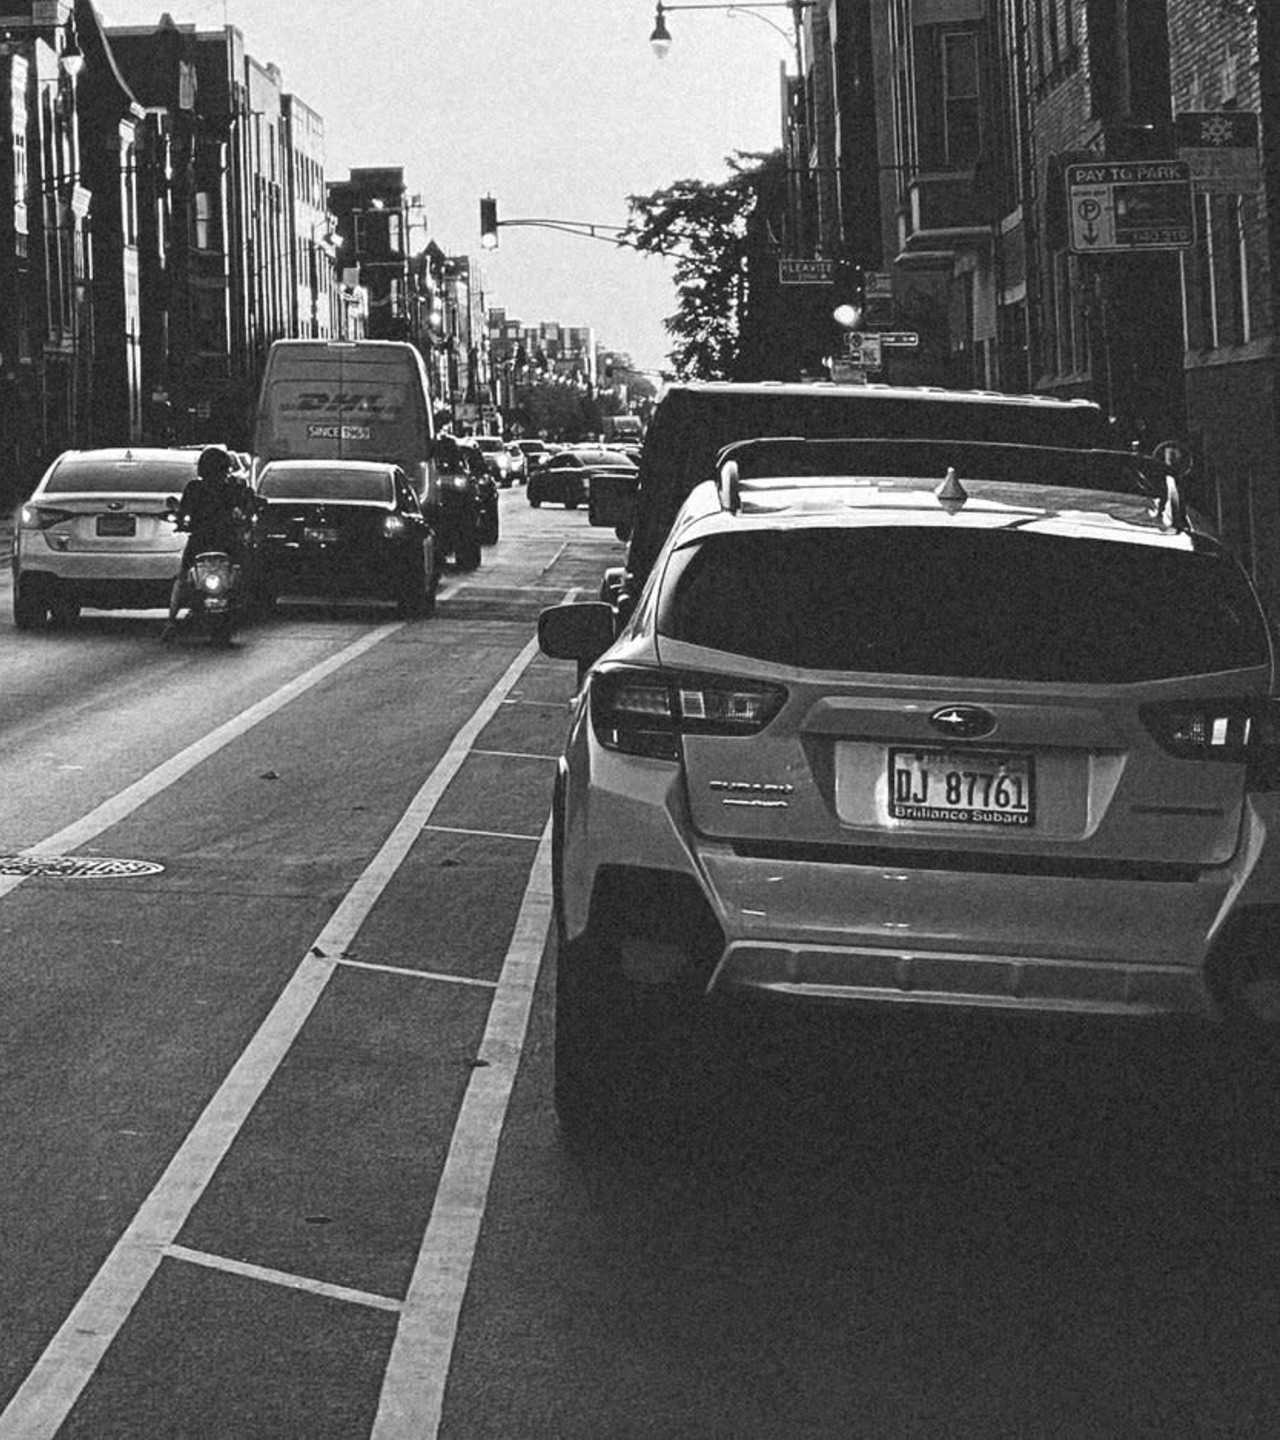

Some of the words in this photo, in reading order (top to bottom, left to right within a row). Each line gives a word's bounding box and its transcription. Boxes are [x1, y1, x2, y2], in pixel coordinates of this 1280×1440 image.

[1076, 168, 1106, 182] PAY
[1111, 167, 1132, 180] TO
[1138, 165, 1182, 179] PARK
[896, 768, 928, 803] DJ
[945, 771, 1027, 810] 87761
[972, 810, 1029, 824] Subaru
